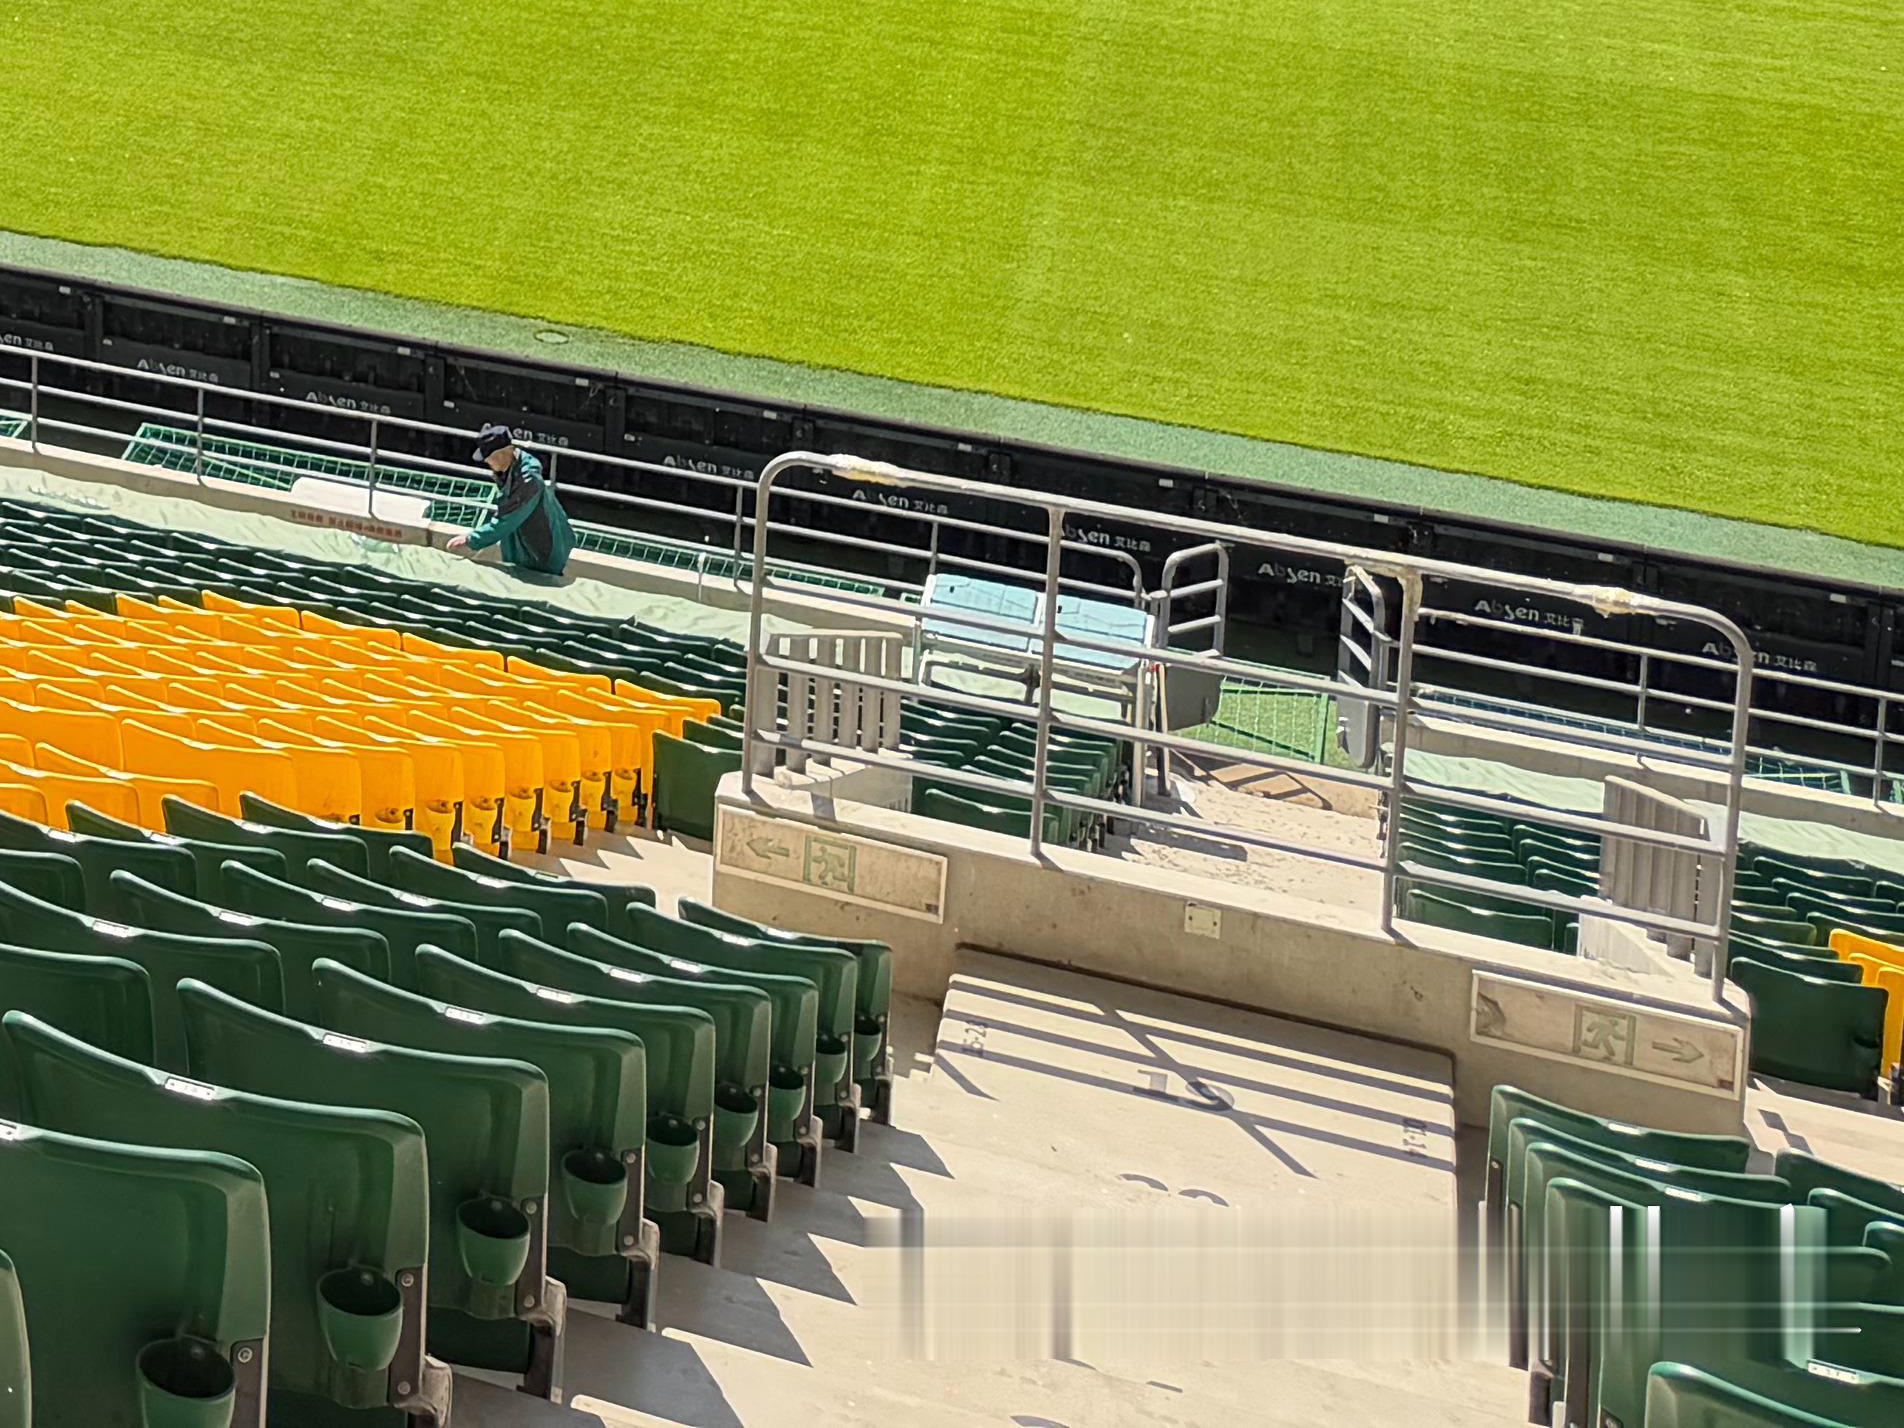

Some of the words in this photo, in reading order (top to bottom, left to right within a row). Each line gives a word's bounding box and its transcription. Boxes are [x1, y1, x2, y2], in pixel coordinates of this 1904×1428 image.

[305, 391, 357, 409] Absen
[663, 455, 717, 474] Absen
[1258, 562, 1321, 584] Absen
[1474, 599, 1540, 622] Absen
